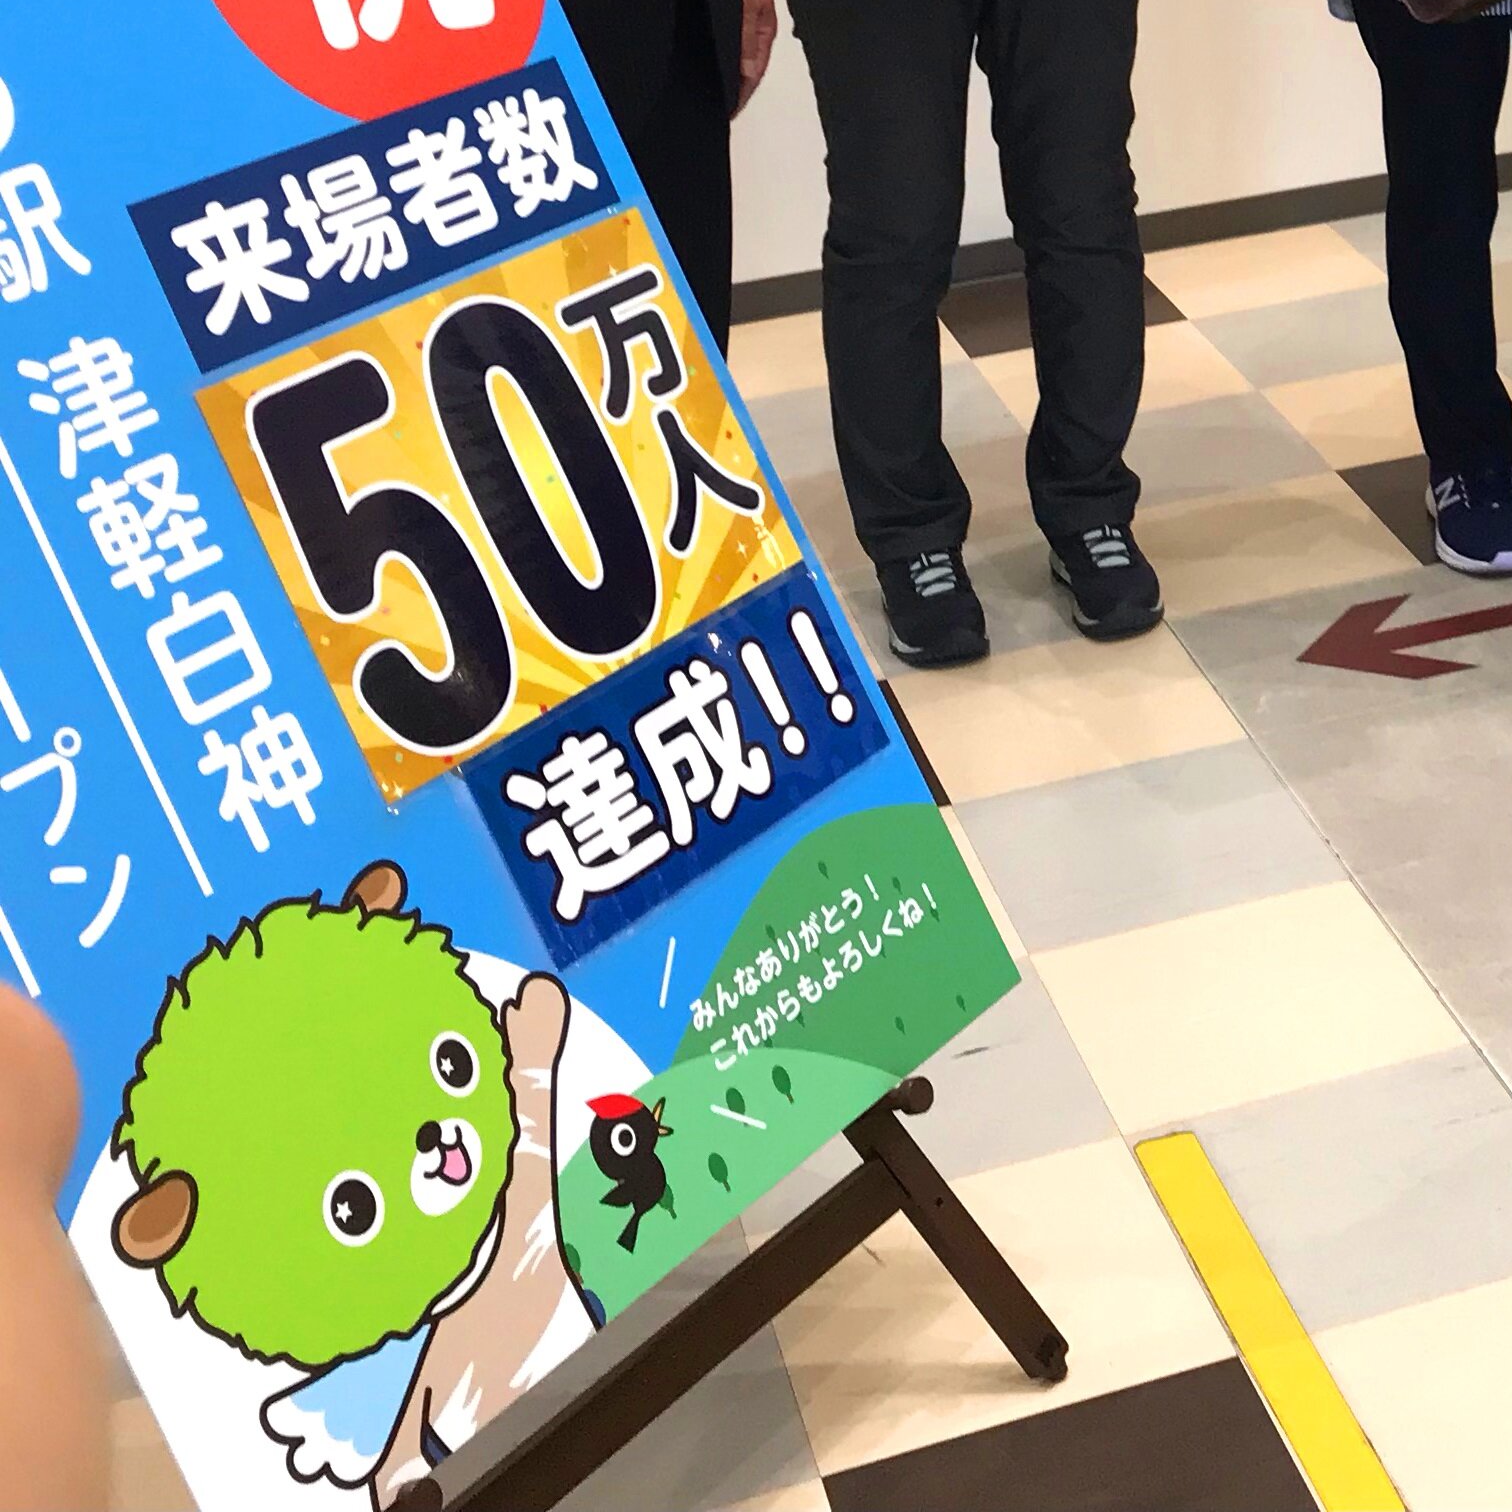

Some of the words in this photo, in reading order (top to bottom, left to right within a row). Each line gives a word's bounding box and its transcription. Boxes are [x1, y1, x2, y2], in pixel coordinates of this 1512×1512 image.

[0, 74, 94, 305] 駅
[171, 86, 599, 337] 来場者数
[16, 335, 326, 854] 津軽白神
[244, 262, 764, 758] 50万人
[689, 873, 880, 1031] みんなありがとう！
[710, 882, 937, 1071] これからもよろしくね！
